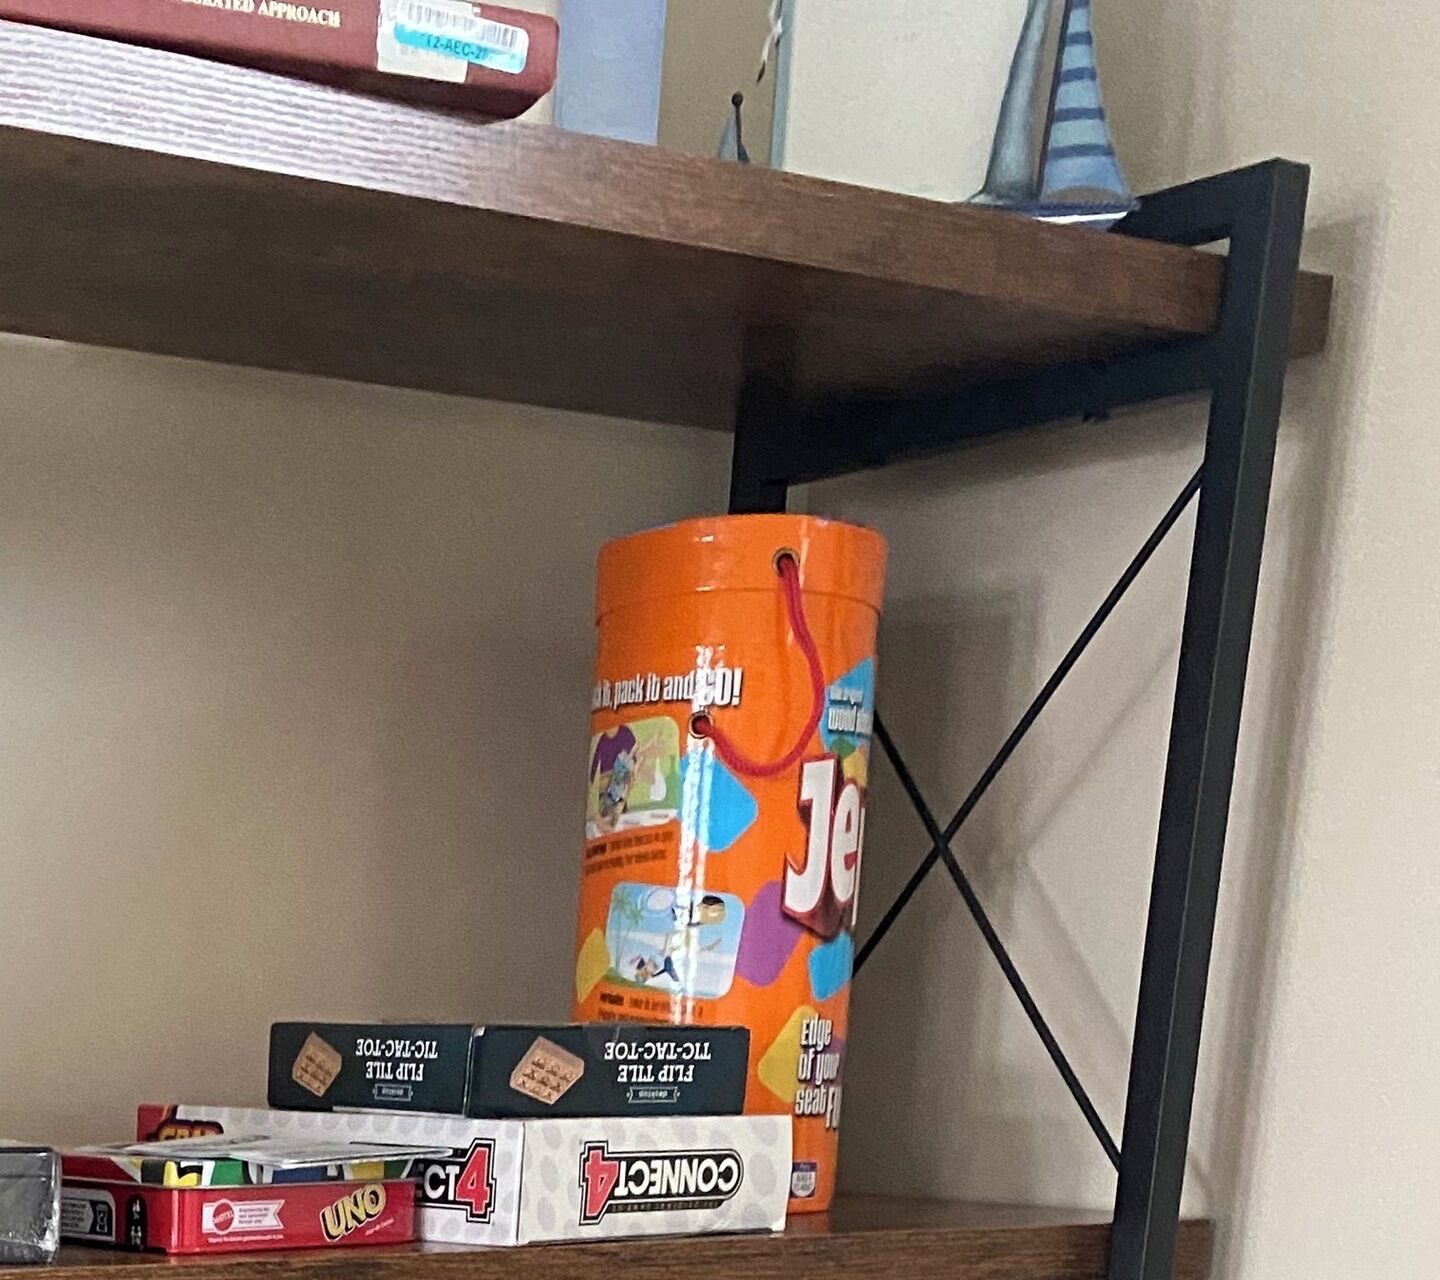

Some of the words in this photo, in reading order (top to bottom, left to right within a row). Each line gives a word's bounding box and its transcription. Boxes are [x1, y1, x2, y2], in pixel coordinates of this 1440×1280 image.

[258, 5, 342, 28] APPROACH
[662, 670, 695, 702] and
[783, 757, 864, 927] Je
[800, 1013, 832, 1050] Edge
[356, 1038, 438, 1059] TIC-TAC-TOE
[605, 1041, 712, 1061] TIC-TAC-TOE
[365, 1061, 394, 1080] TILE
[396, 1061, 425, 1081] FLIP
[616, 1064, 654, 1082] TILE
[657, 1064, 695, 1083] FLIP
[797, 1048, 815, 1081] of
[795, 1084, 827, 1116] seat
[613, 1156, 738, 1197] CONNECT
[320, 1184, 387, 1242] UNO
